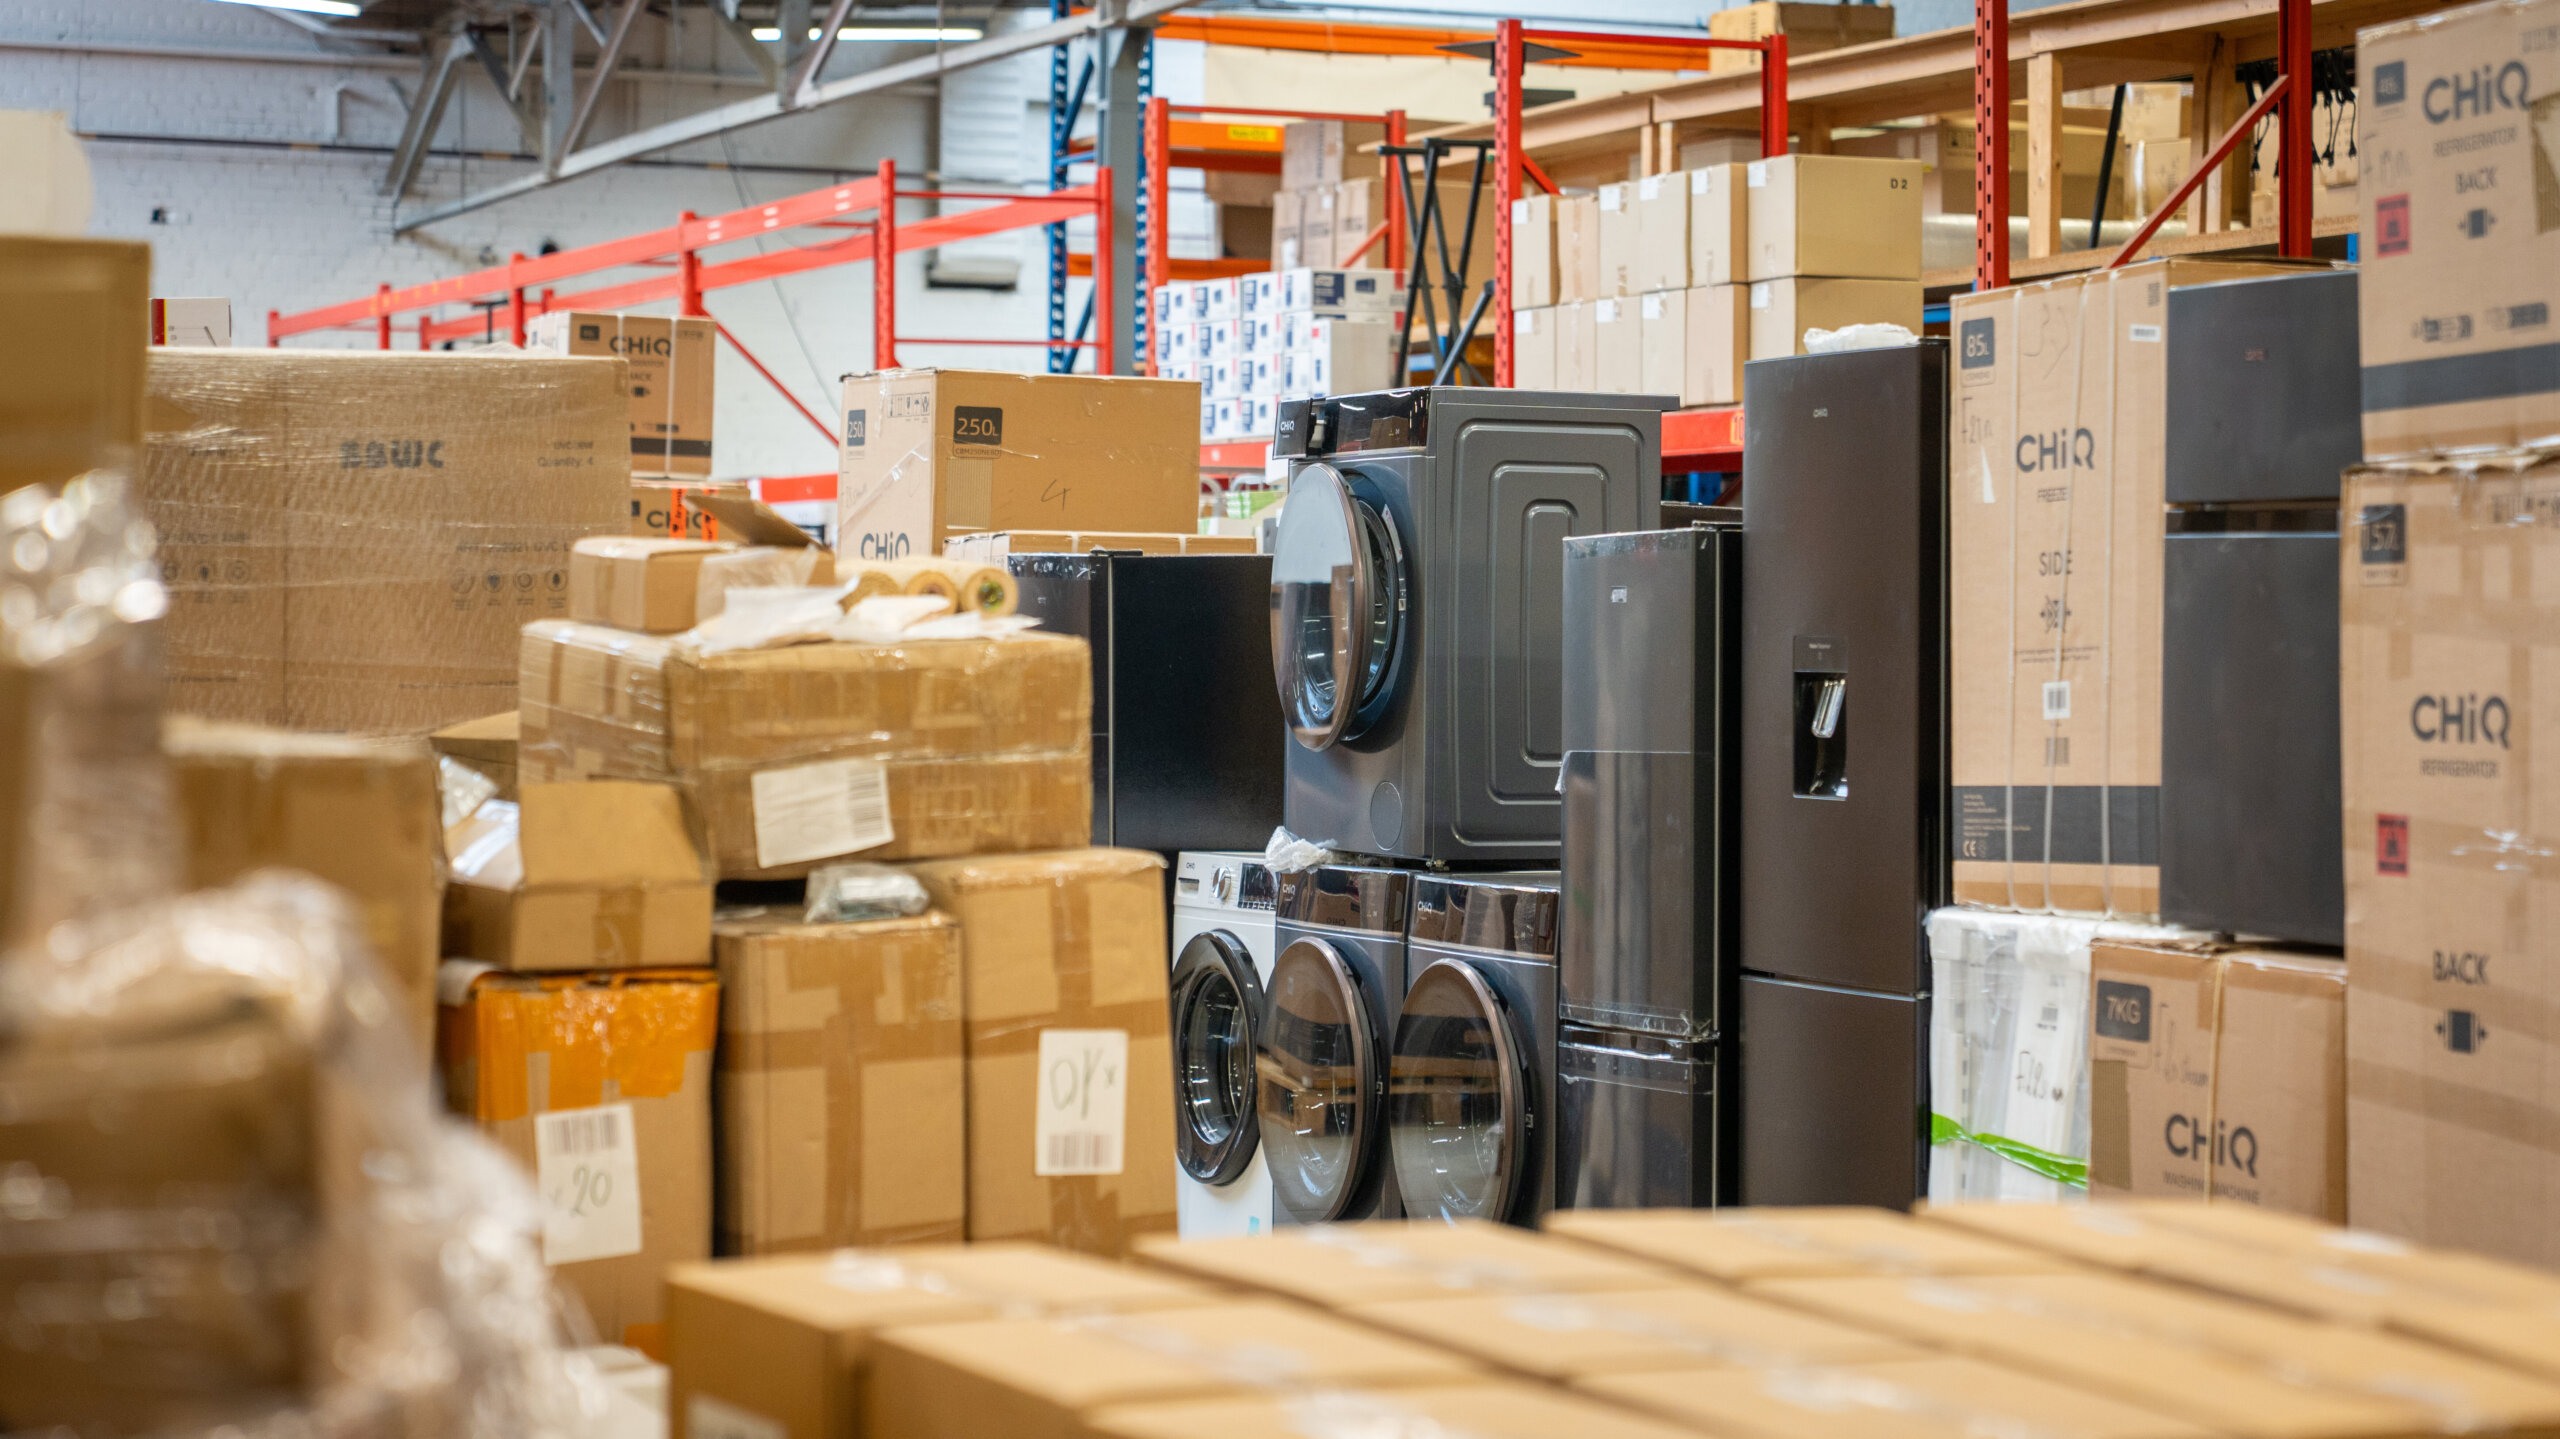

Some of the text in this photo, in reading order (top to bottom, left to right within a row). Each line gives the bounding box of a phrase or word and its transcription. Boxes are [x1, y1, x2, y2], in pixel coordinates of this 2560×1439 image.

[2423, 60, 2531, 125] CHiQ
[2433, 127, 2518, 158] REFRIGERATOR
[2455, 166, 2498, 194] BACK
[609, 335, 671, 358] CHiQ
[956, 417, 1000, 437] 250L
[2016, 428, 2095, 473] CHiQ
[2410, 692, 2511, 750] CHiQ
[2419, 757, 2499, 780] REFRIGERATOR
[2432, 950, 2490, 986] BACK
[2106, 995, 2142, 1025] 7KG
[2165, 1113, 2258, 1179] CHiQ
